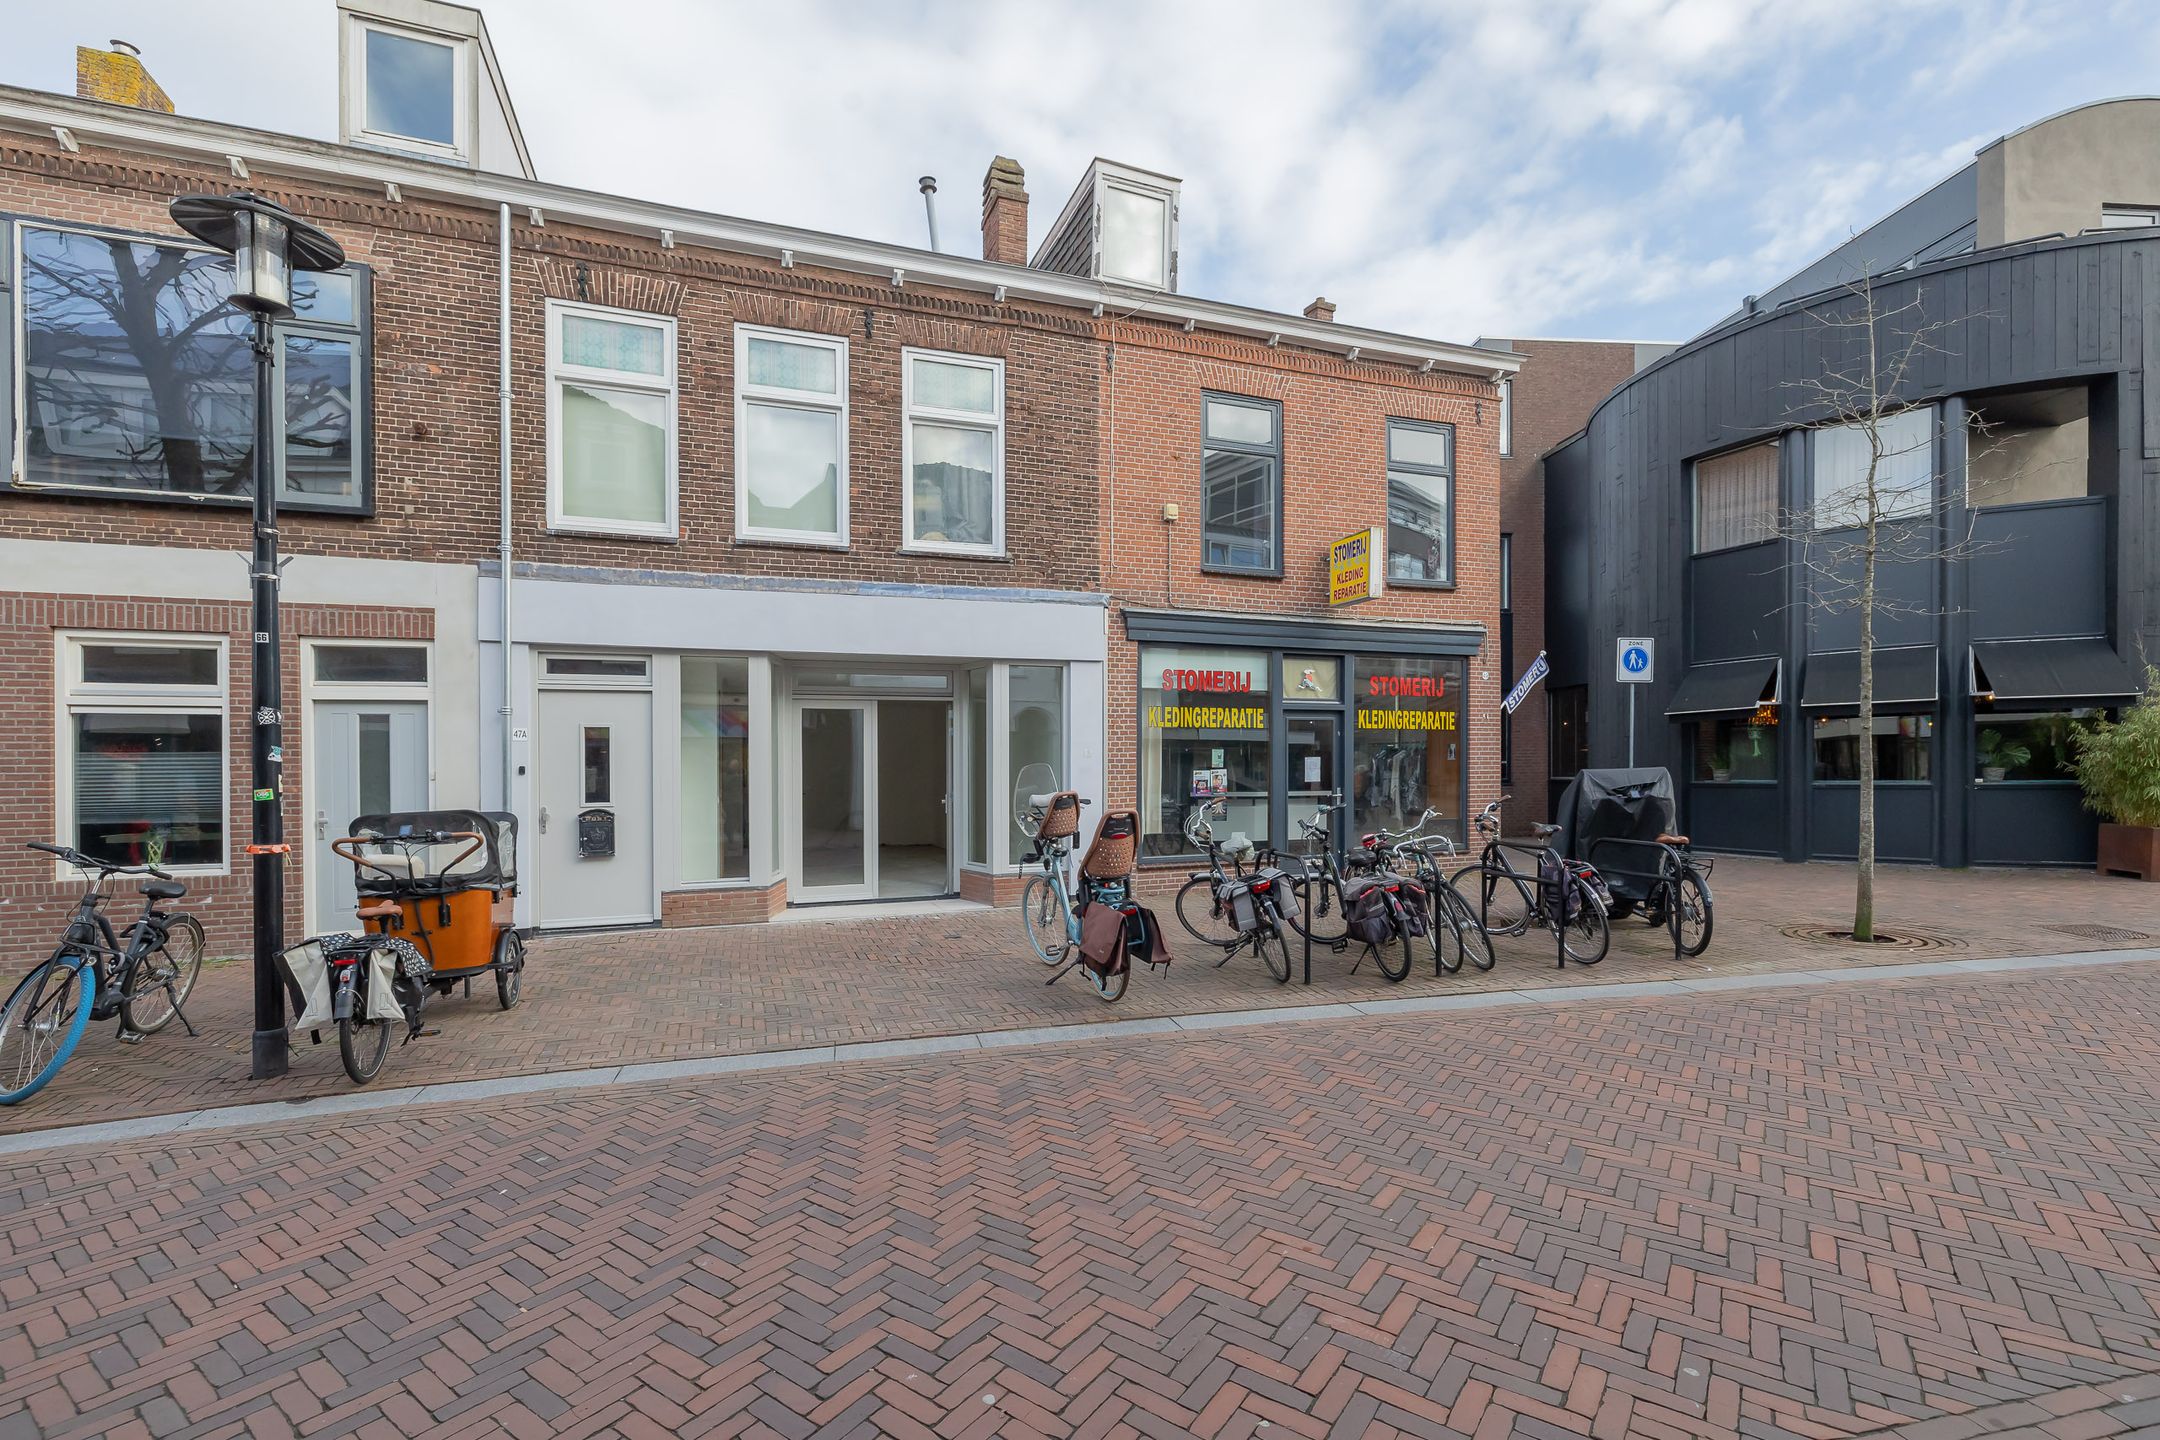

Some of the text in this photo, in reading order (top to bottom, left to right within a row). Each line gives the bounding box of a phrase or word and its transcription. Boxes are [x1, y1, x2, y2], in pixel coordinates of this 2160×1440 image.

[1334, 536, 1367, 563] STOMERIJ
[1336, 566, 1364, 585] KLEDING
[1334, 581, 1366, 600] REPARATIE
[257, 633, 267, 641] 66
[1161, 668, 1251, 693] STOMERIJ
[1369, 675, 1446, 698] STOMERIJ
[1147, 705, 1264, 729] KLEDINGREPARATIE
[1358, 709, 1456, 731] KLEDINGREPARATIE
[513, 730, 527, 738] 47A
